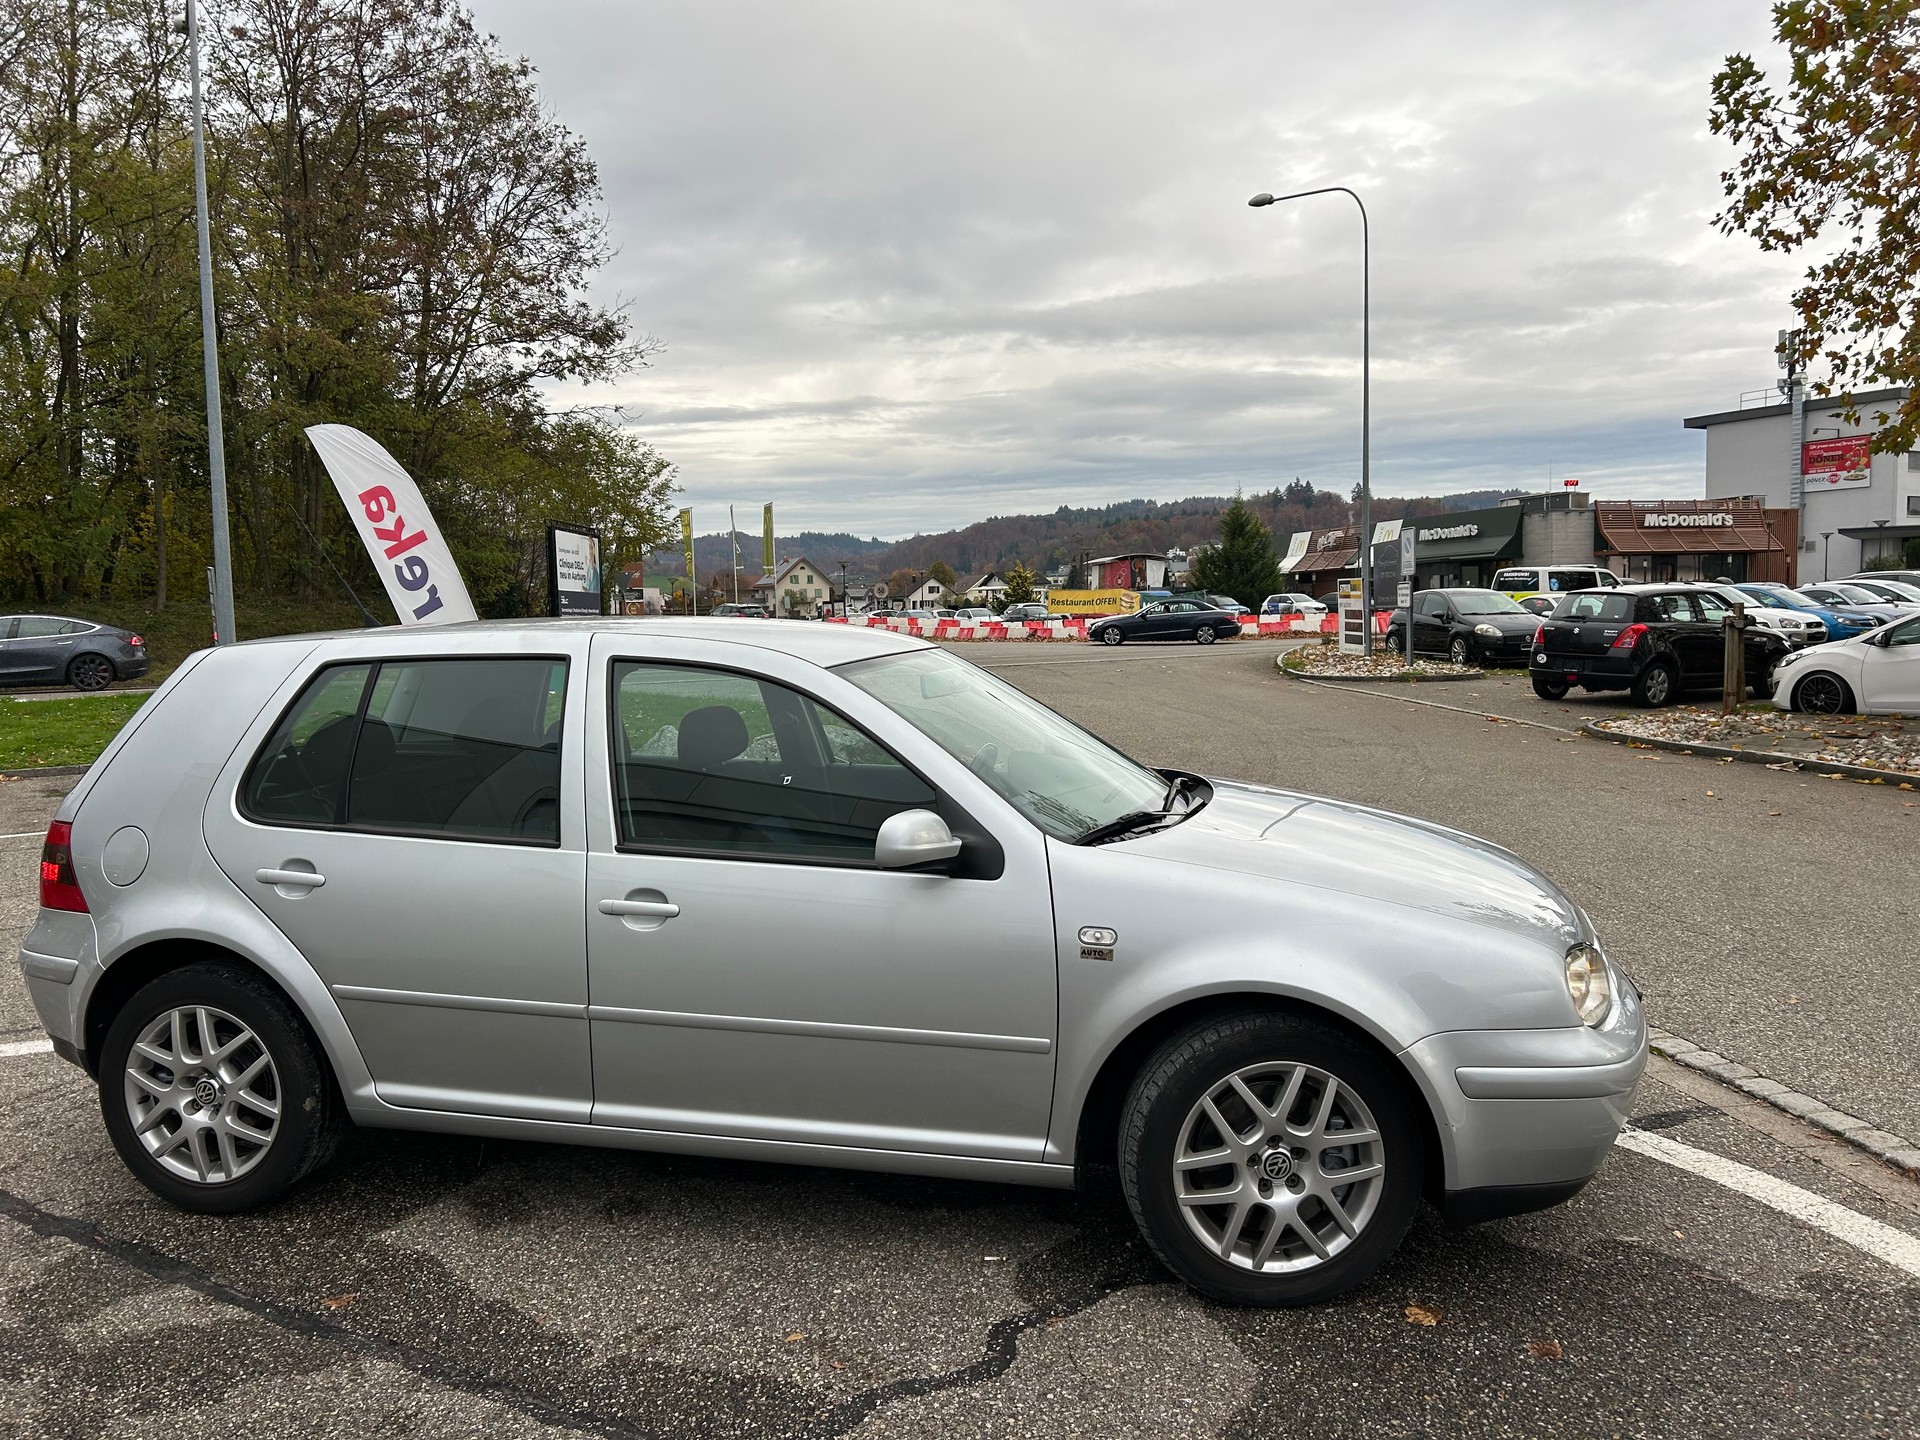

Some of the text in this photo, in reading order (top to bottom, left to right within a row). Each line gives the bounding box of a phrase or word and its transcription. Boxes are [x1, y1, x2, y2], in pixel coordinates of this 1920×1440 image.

[1809, 453, 1844, 464] DÖNER
[1644, 513, 1733, 527] McDonald's
[1419, 523, 1478, 541] McDonald's
[558, 558, 574, 572] Clinique
[559, 571, 567, 579] neu
[571, 571, 586, 583] Aarburg
[1050, 597, 1117, 607] Restaurant OFFEN
[1538, 655, 1546, 663] CH
[1081, 949, 1105, 957] AUTO
